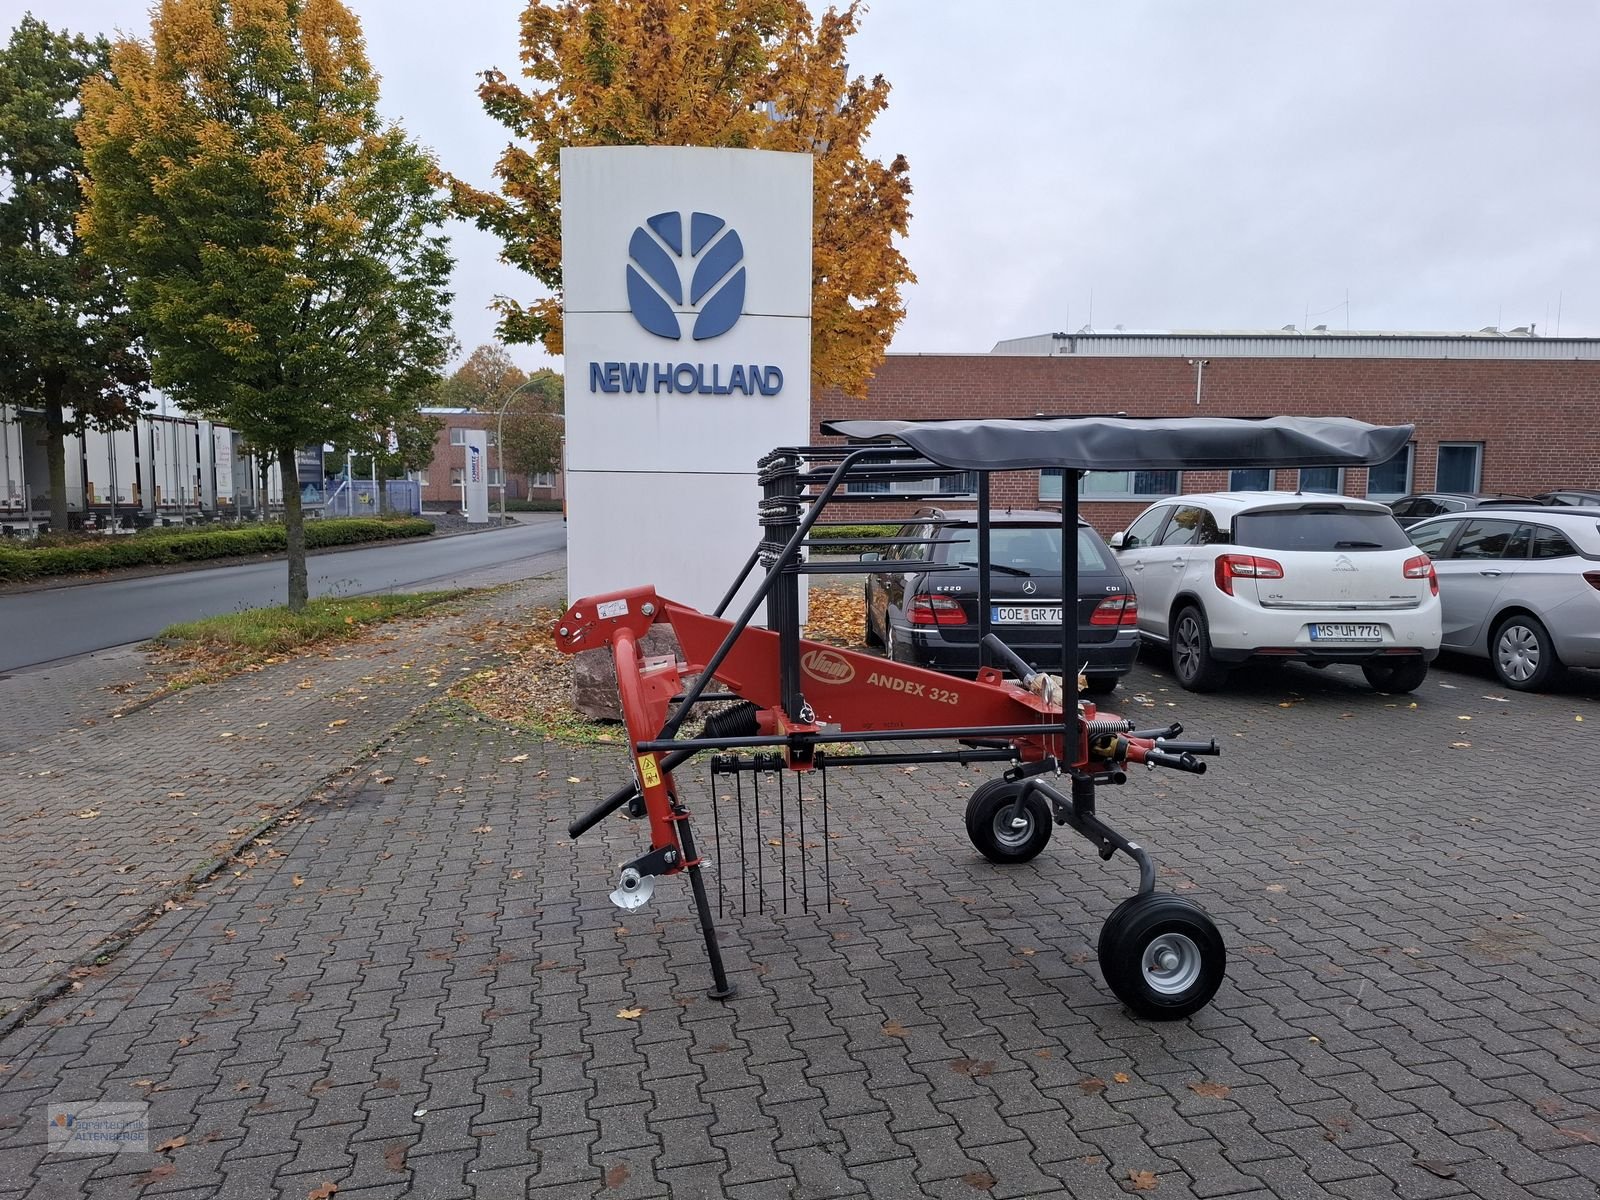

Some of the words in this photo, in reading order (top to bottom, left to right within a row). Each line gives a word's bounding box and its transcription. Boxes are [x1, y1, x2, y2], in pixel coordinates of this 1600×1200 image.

[589, 361, 649, 393] NEW
[653, 362, 784, 396] HOLLAND
[999, 608, 1023, 620] COE
[1031, 608, 1047, 620] GR
[1317, 625, 1334, 636] MS
[808, 650, 850, 678] Vicon
[866, 672, 927, 697] ANDEX
[928, 687, 960, 705] 323
